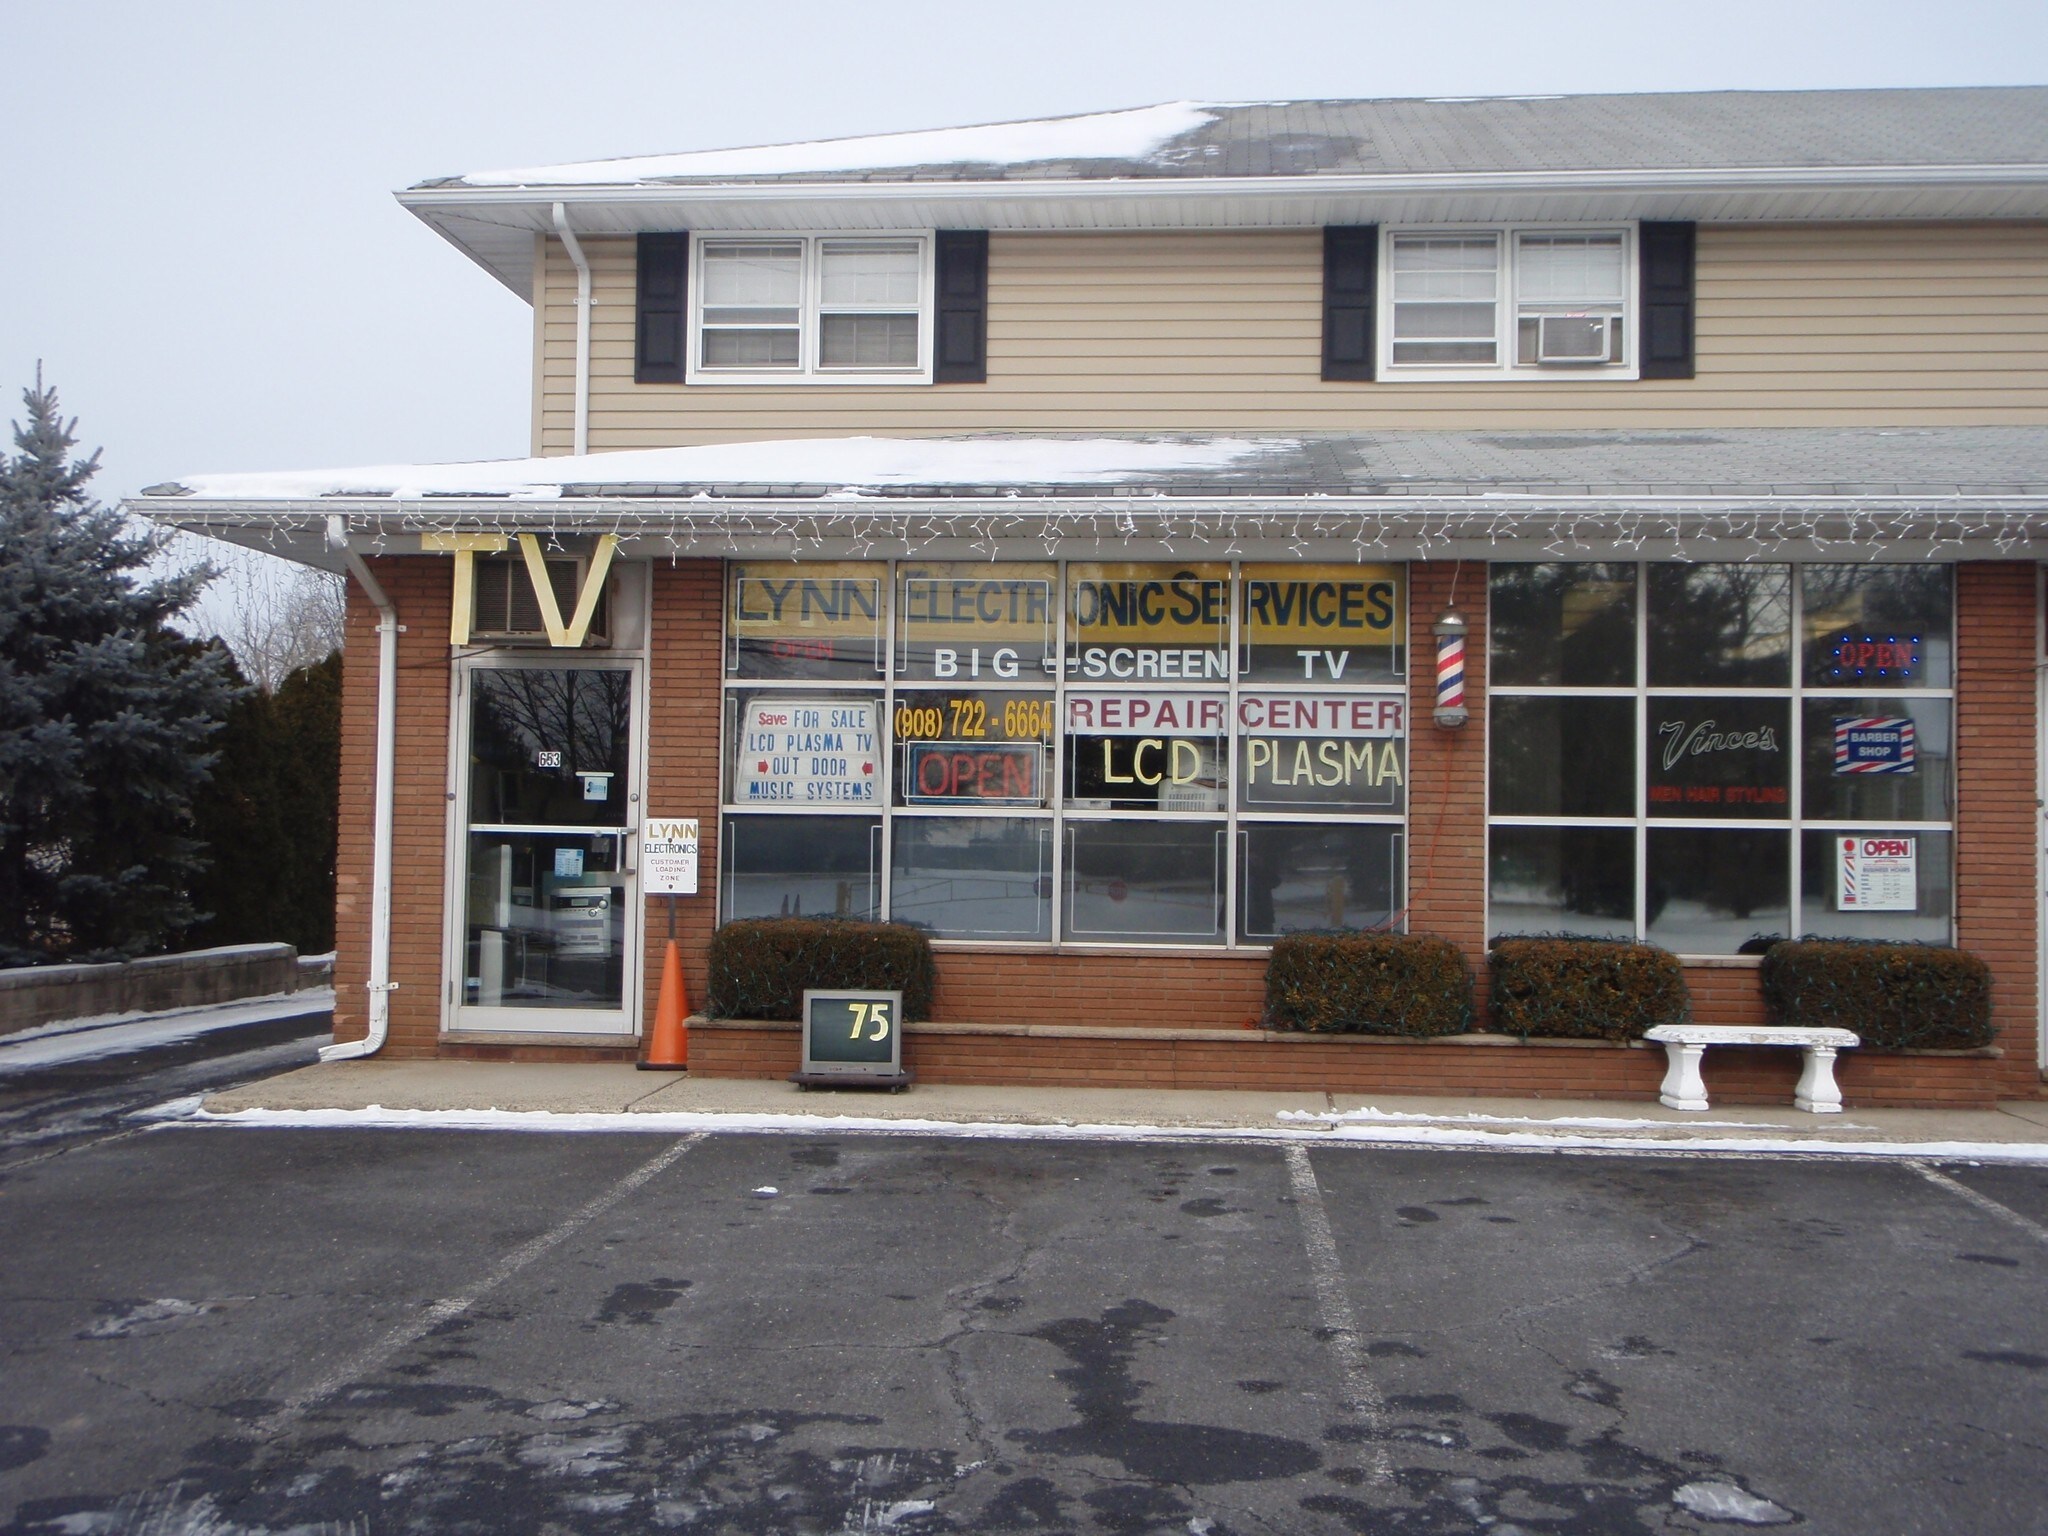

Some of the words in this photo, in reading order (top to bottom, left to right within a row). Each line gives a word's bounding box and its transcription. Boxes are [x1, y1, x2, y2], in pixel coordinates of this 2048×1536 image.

[421, 533, 618, 647] TV
[735, 567, 880, 621] LYNN
[772, 638, 834, 660] OPEN
[1840, 642, 1914, 668] OPEN
[935, 648, 1019, 678] BIG
[1297, 650, 1350, 679] TV
[758, 712, 788, 726] Save
[794, 709, 820, 728] FOR
[831, 709, 866, 728] SALE
[895, 707, 943, 738] (908)
[1069, 698, 1225, 729] REPAIR
[1238, 698, 1402, 731] CENTER
[749, 733, 775, 752] LCD
[787, 733, 844, 752] PLASMA
[856, 733, 873, 752] TV
[1659, 719, 1779, 771] Vince's
[1850, 732, 1899, 742] BARBER
[540, 753, 560, 766] 653
[1858, 746, 1892, 757] SHOP
[772, 756, 800, 775] OUT
[812, 757, 847, 776] DOOR
[1103, 739, 1202, 786] LCD
[1248, 739, 1403, 787] PLASMA
[918, 752, 1032, 797] OPEN
[749, 781, 794, 799] MUSIC
[807, 781, 872, 800] SYSTEMS
[649, 823, 697, 839] LYNN
[644, 843, 697, 854] ELECTRONICS
[1864, 840, 1909, 856] OPEN
[848, 1003, 889, 1042] 75
